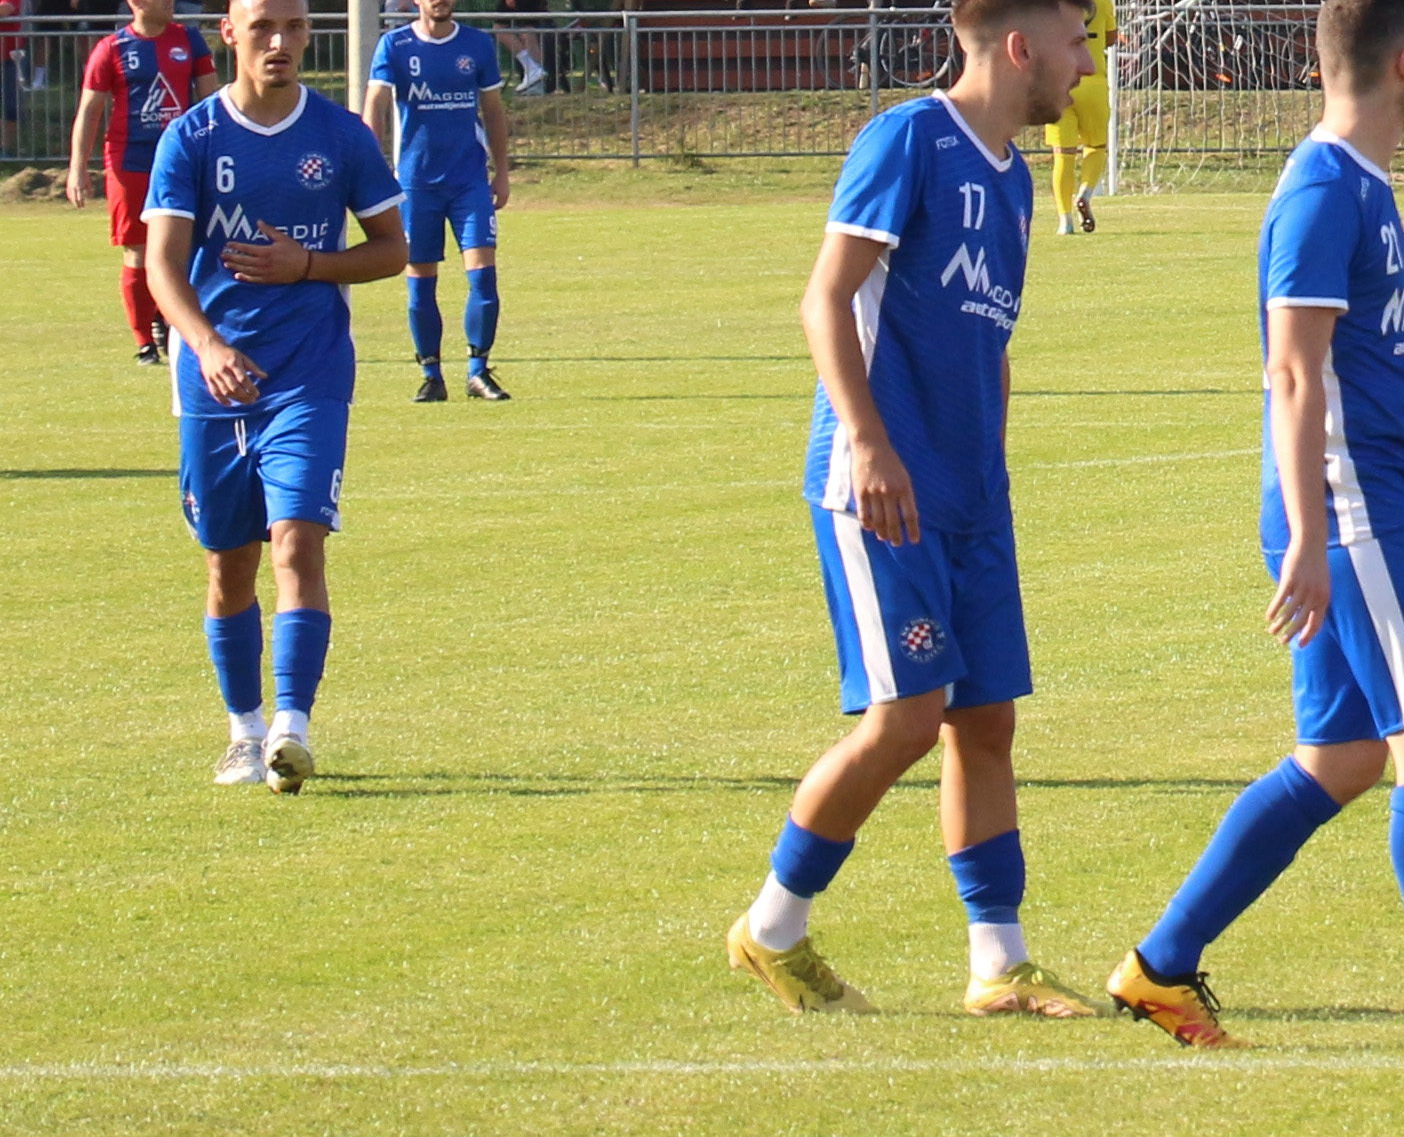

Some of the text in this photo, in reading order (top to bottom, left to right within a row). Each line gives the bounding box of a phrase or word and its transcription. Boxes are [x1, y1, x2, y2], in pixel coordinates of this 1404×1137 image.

[128, 51, 139, 70] 5
[409, 55, 420, 76] 9
[216, 155, 235, 193] 6
[959, 182, 986, 230] 17
[1380, 221, 1404, 275] 21
[330, 468, 341, 503] 6
